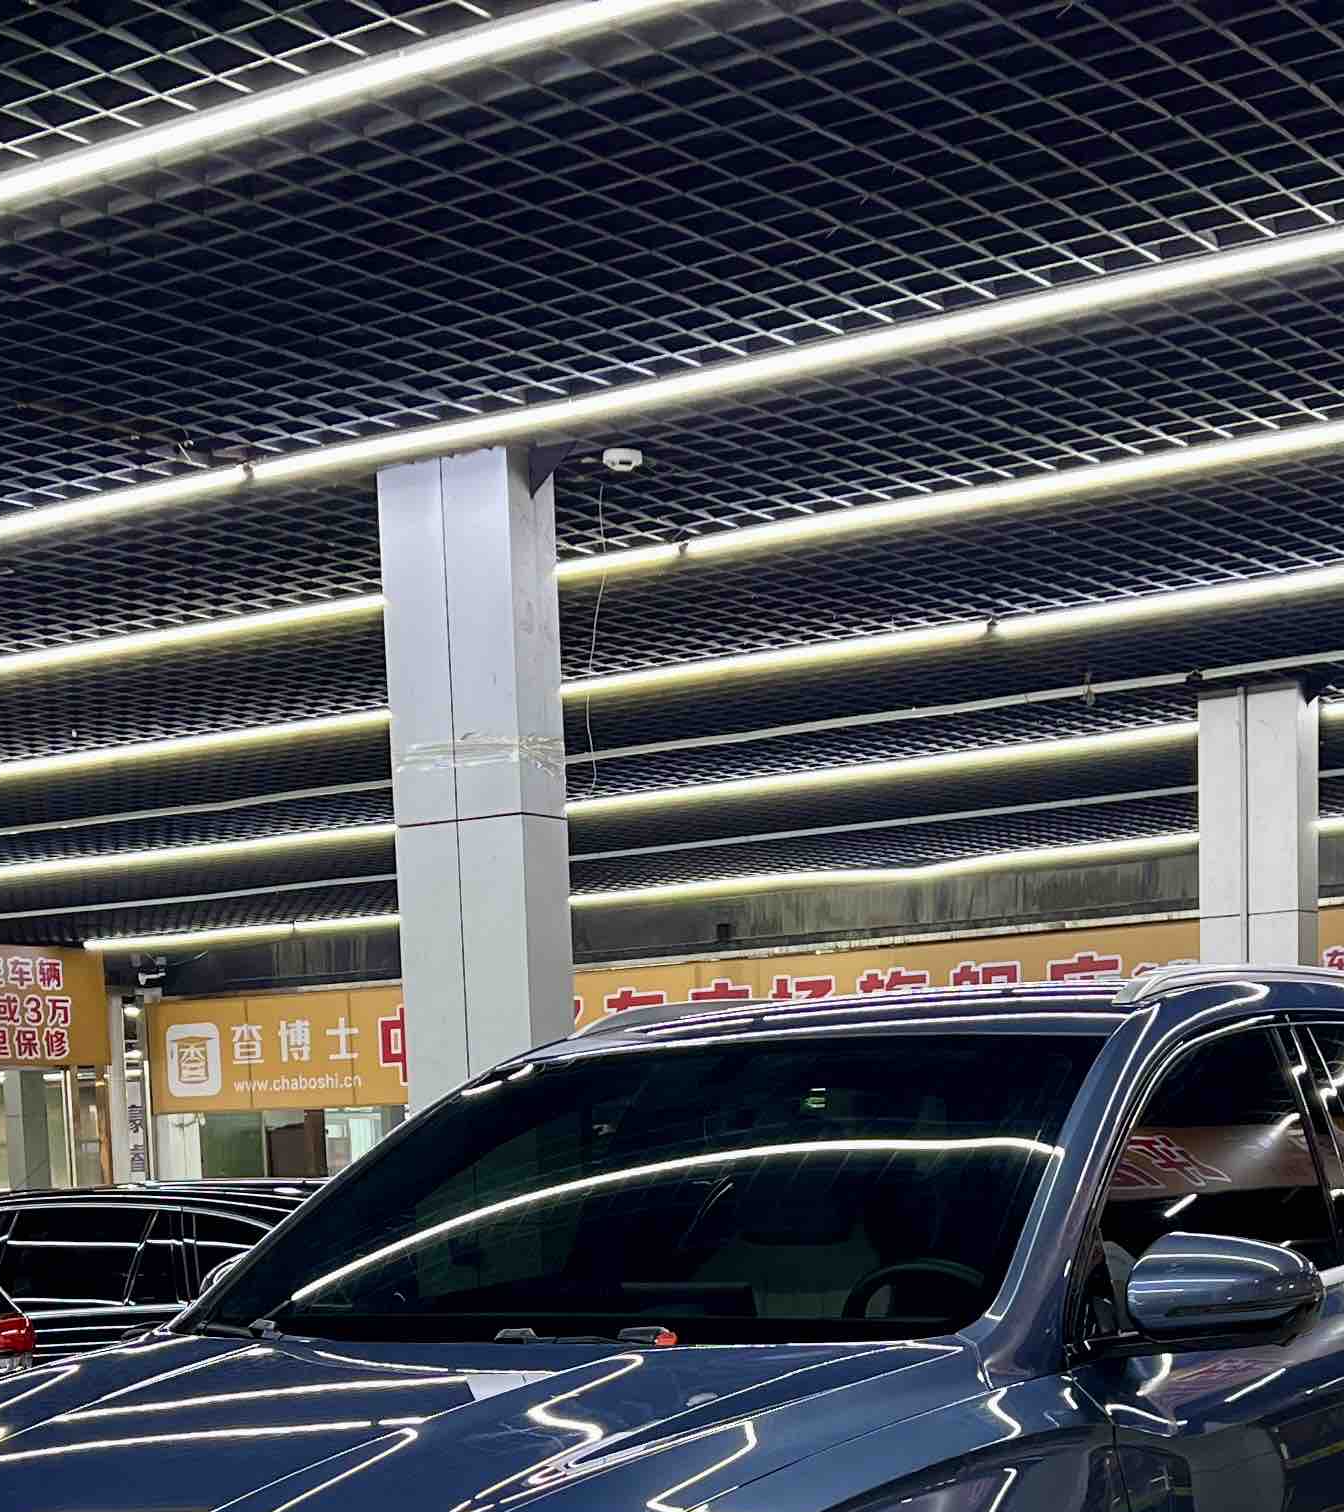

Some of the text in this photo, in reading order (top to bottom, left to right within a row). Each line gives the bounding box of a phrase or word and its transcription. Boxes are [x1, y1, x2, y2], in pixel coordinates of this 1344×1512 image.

[231, 1016, 360, 1065] 查博士
[233, 1073, 362, 1093] www.chaboshi.cn
